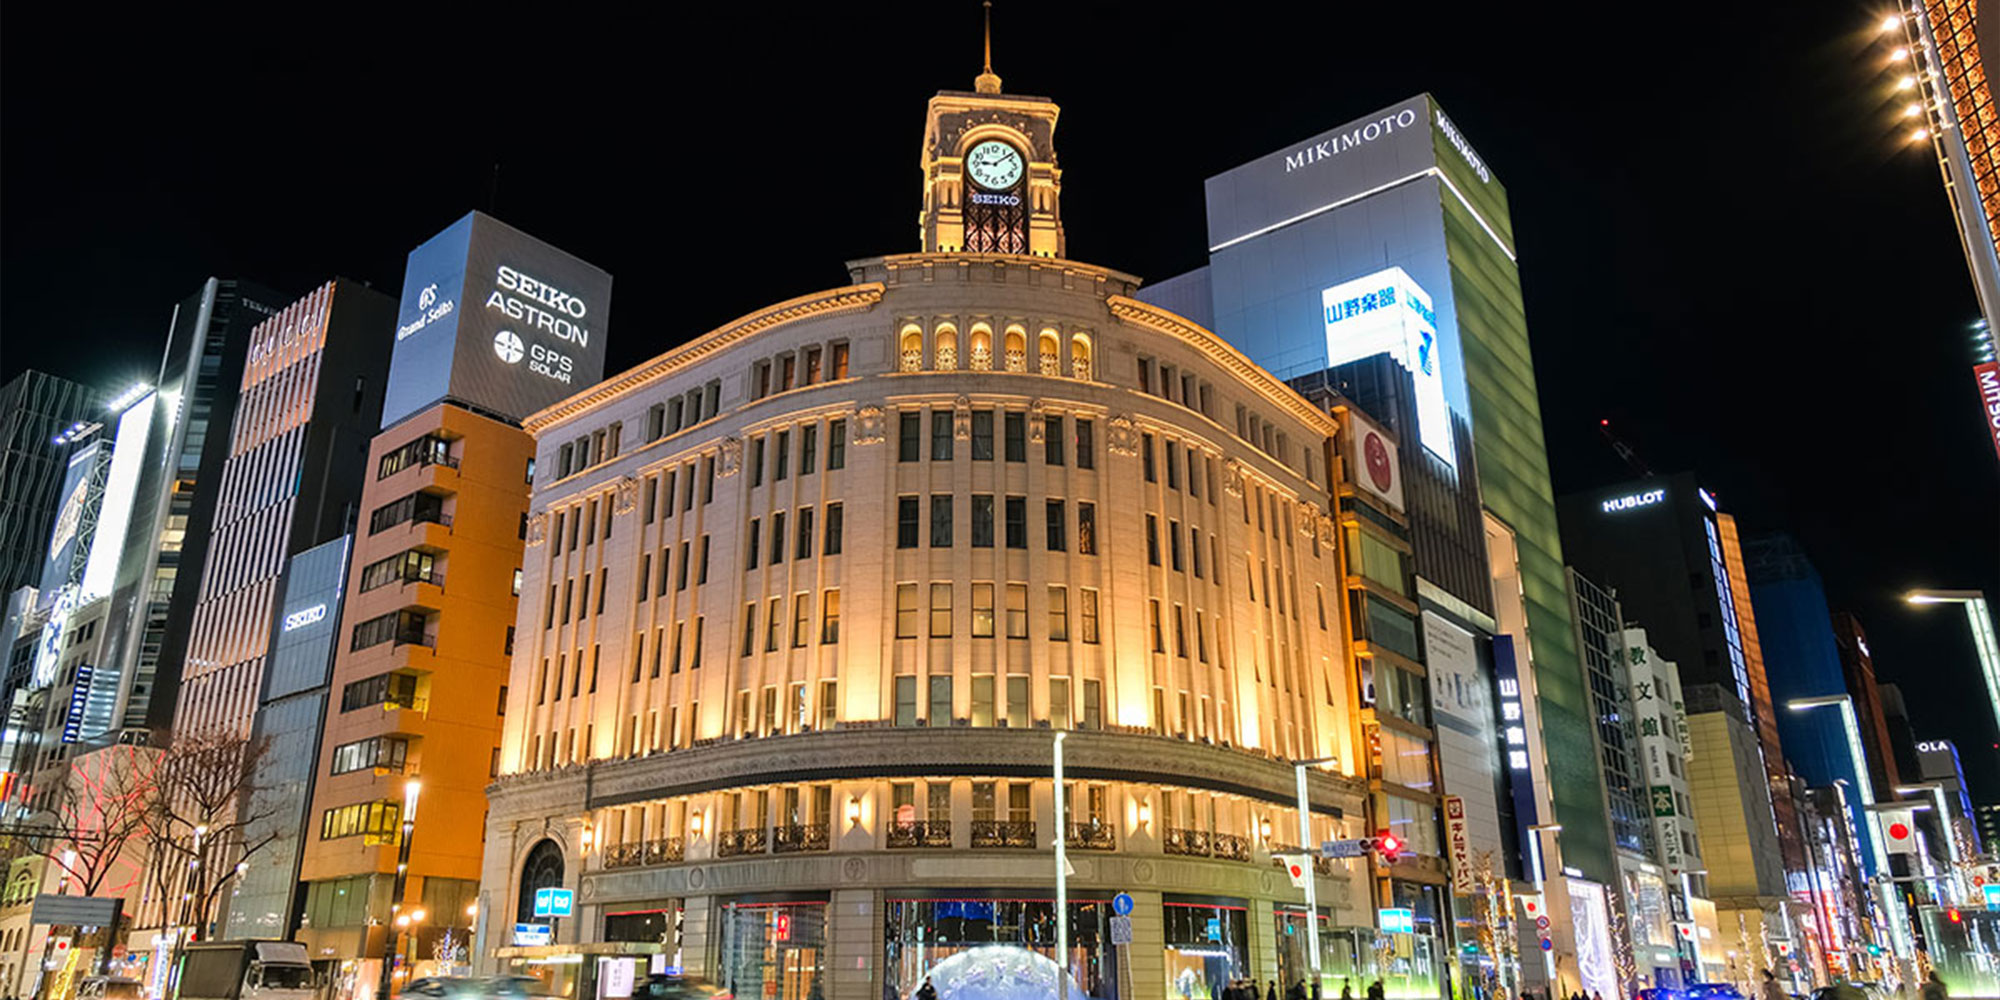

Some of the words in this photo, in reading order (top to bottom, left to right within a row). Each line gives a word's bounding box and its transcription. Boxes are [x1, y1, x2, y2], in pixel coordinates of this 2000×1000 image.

[1285, 109, 1416, 172] MIKIMOTO
[1436, 110, 1489, 184] MIKIMOTO
[972, 193, 1020, 206] SEIKO
[497, 265, 587, 319] SEIKO
[1326, 286, 1396, 324] 山野楽器
[486, 290, 589, 348] ASTRON
[529, 360, 572, 384] SOLAR
[530, 343, 574, 373] GPS
[1979, 370, 2000, 446] MITSU
[1603, 489, 1664, 512] HUBLOT
[1629, 646, 1659, 737] 教文館
[1915, 740, 1949, 752] OLA
